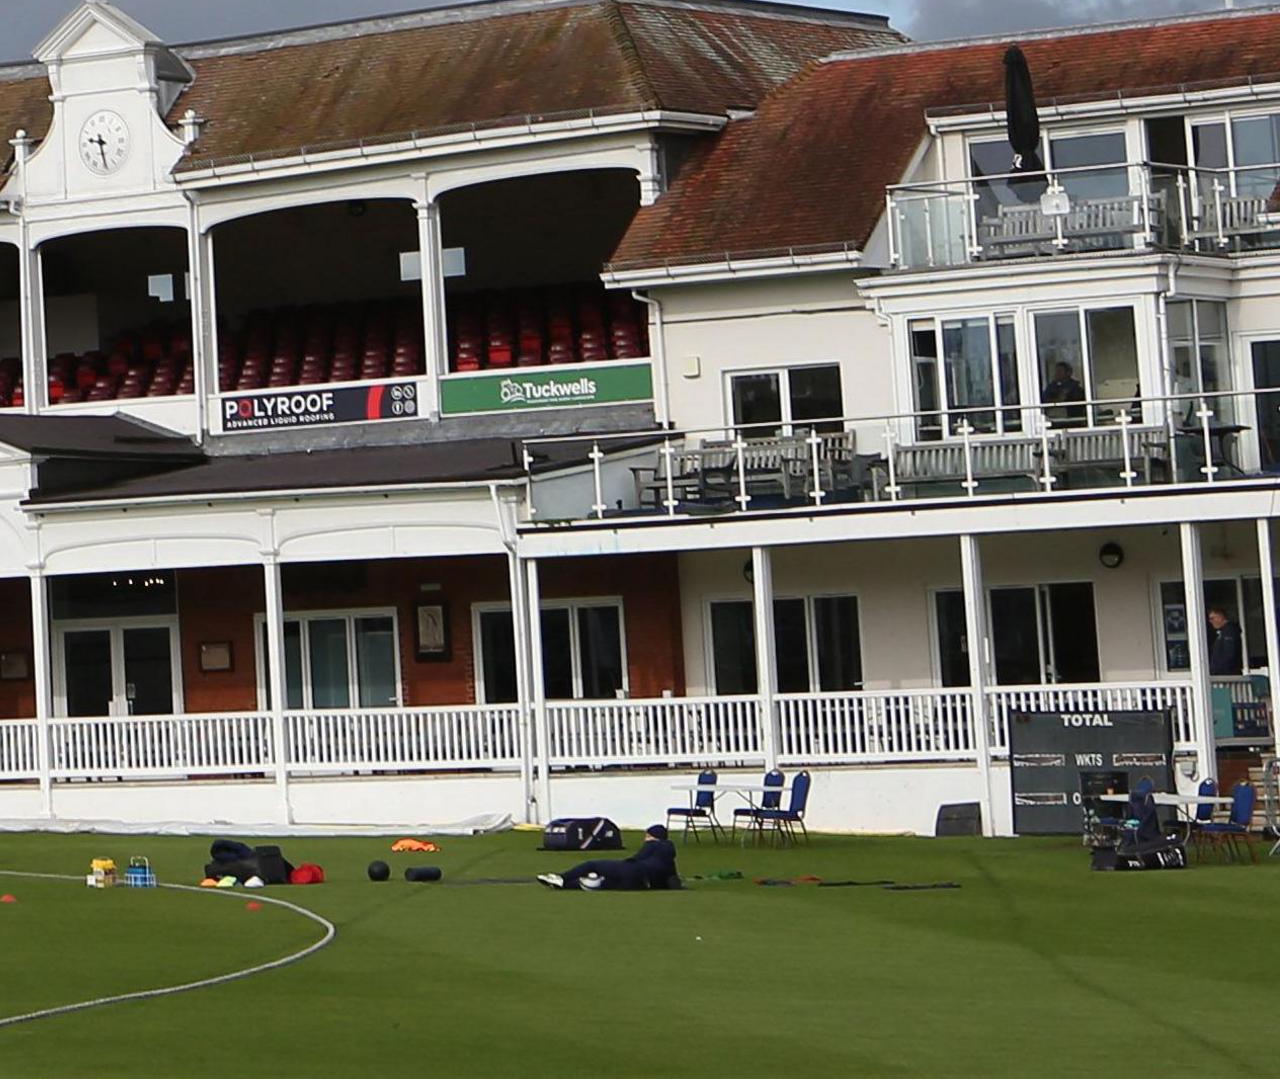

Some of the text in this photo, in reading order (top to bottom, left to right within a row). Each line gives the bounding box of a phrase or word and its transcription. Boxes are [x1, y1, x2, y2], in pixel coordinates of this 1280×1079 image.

[522, 377, 597, 398] Tuckwells
[225, 392, 334, 419] POLYROOF
[226, 413, 335, 428] ADVANCED LIQUID ROOFING
[1060, 713, 1114, 727] TOTAL
[1074, 753, 1104, 767] WKTS
